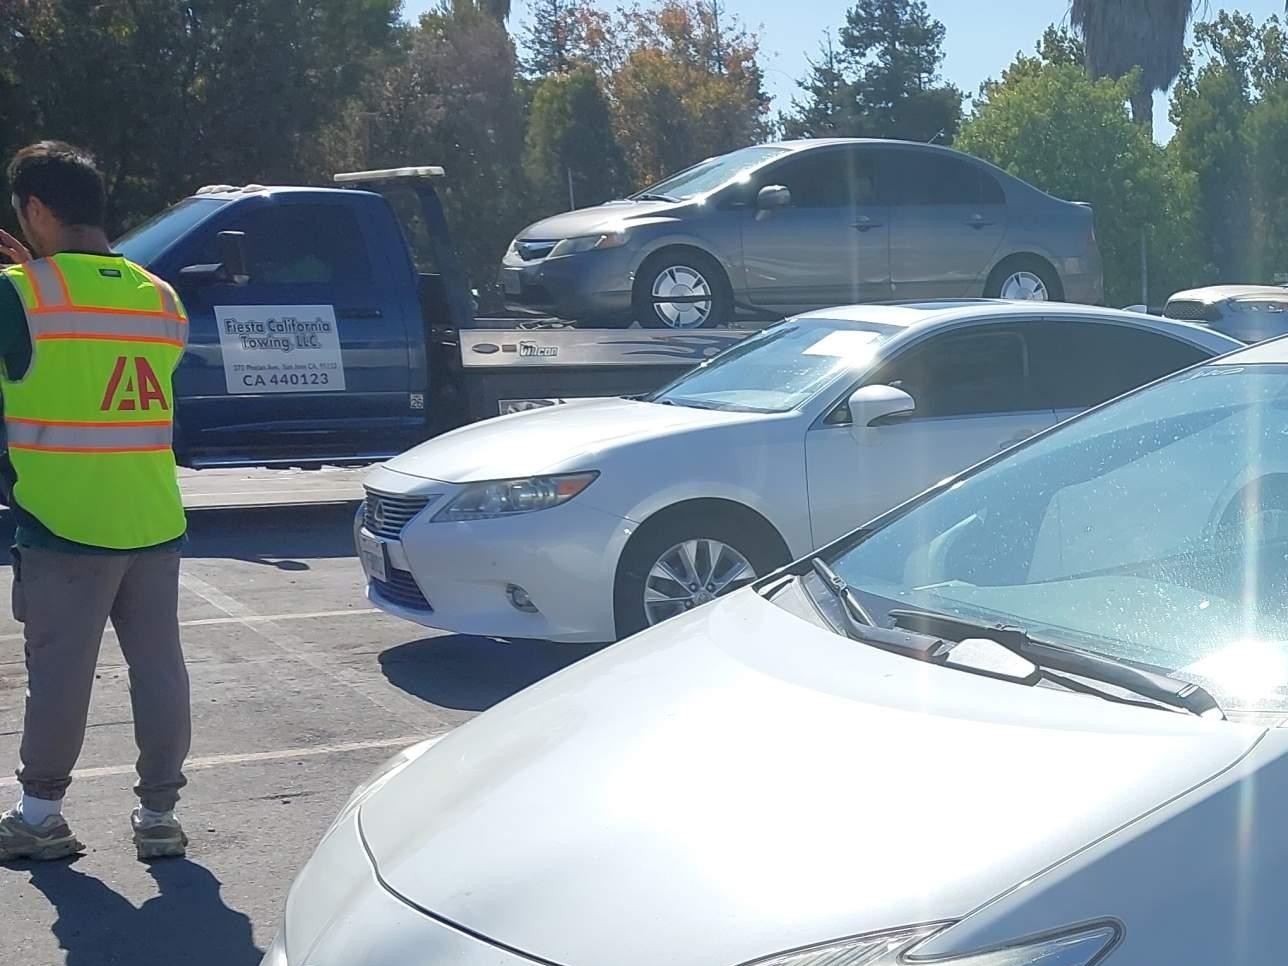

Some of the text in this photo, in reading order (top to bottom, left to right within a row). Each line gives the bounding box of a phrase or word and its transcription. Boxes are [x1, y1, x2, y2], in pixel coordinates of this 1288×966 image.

[225, 317, 331, 334] Fiesta California
[243, 373, 329, 387] CA 440123
